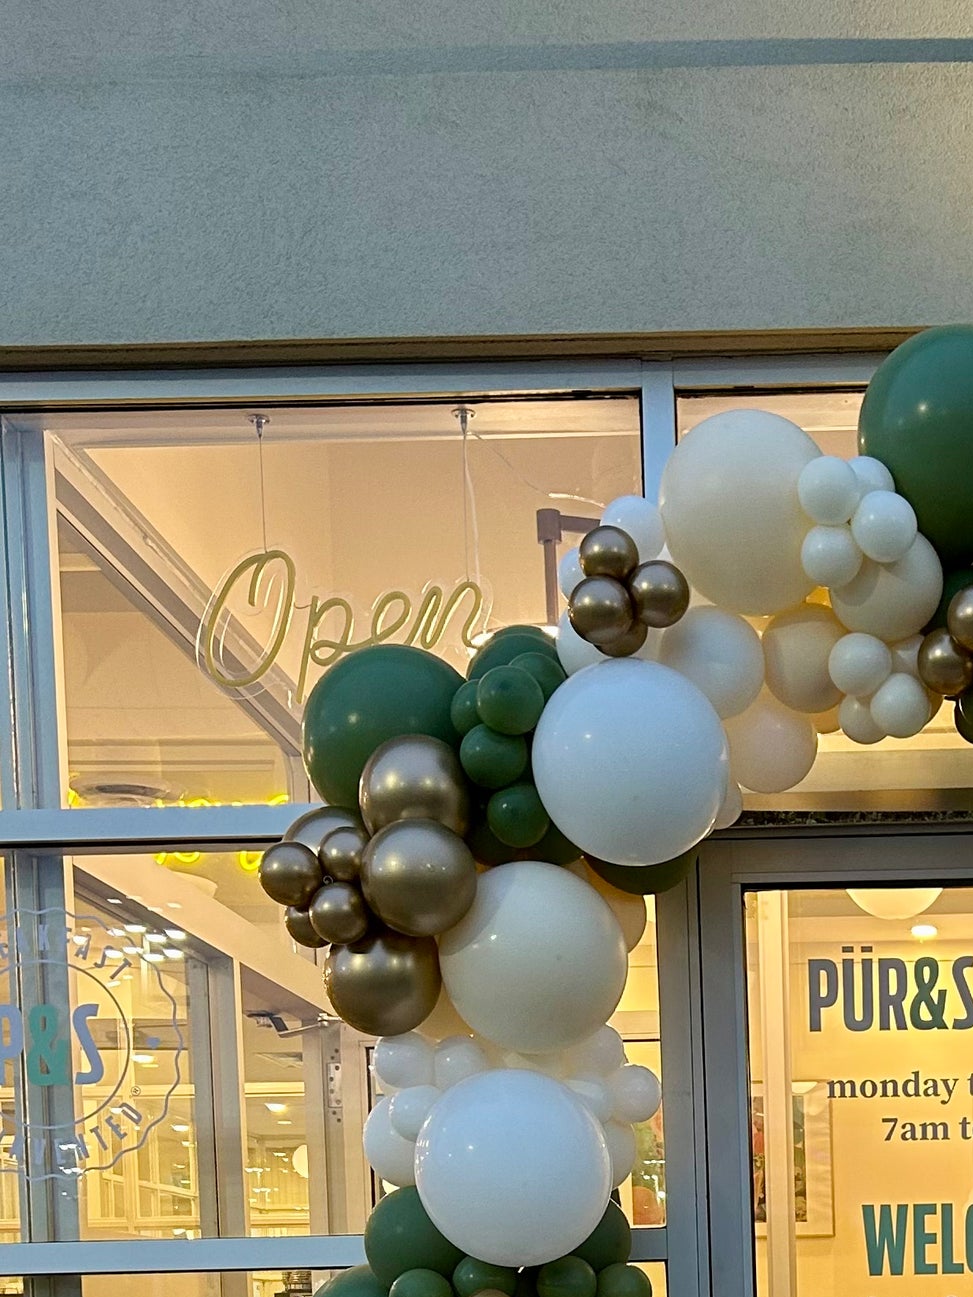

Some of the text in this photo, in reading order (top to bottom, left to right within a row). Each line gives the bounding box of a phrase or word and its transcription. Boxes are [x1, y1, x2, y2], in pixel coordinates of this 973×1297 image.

[205, 550, 483, 704] Open
[826, 1071, 959, 1105] monday
[881, 1117, 952, 1141] 7am
